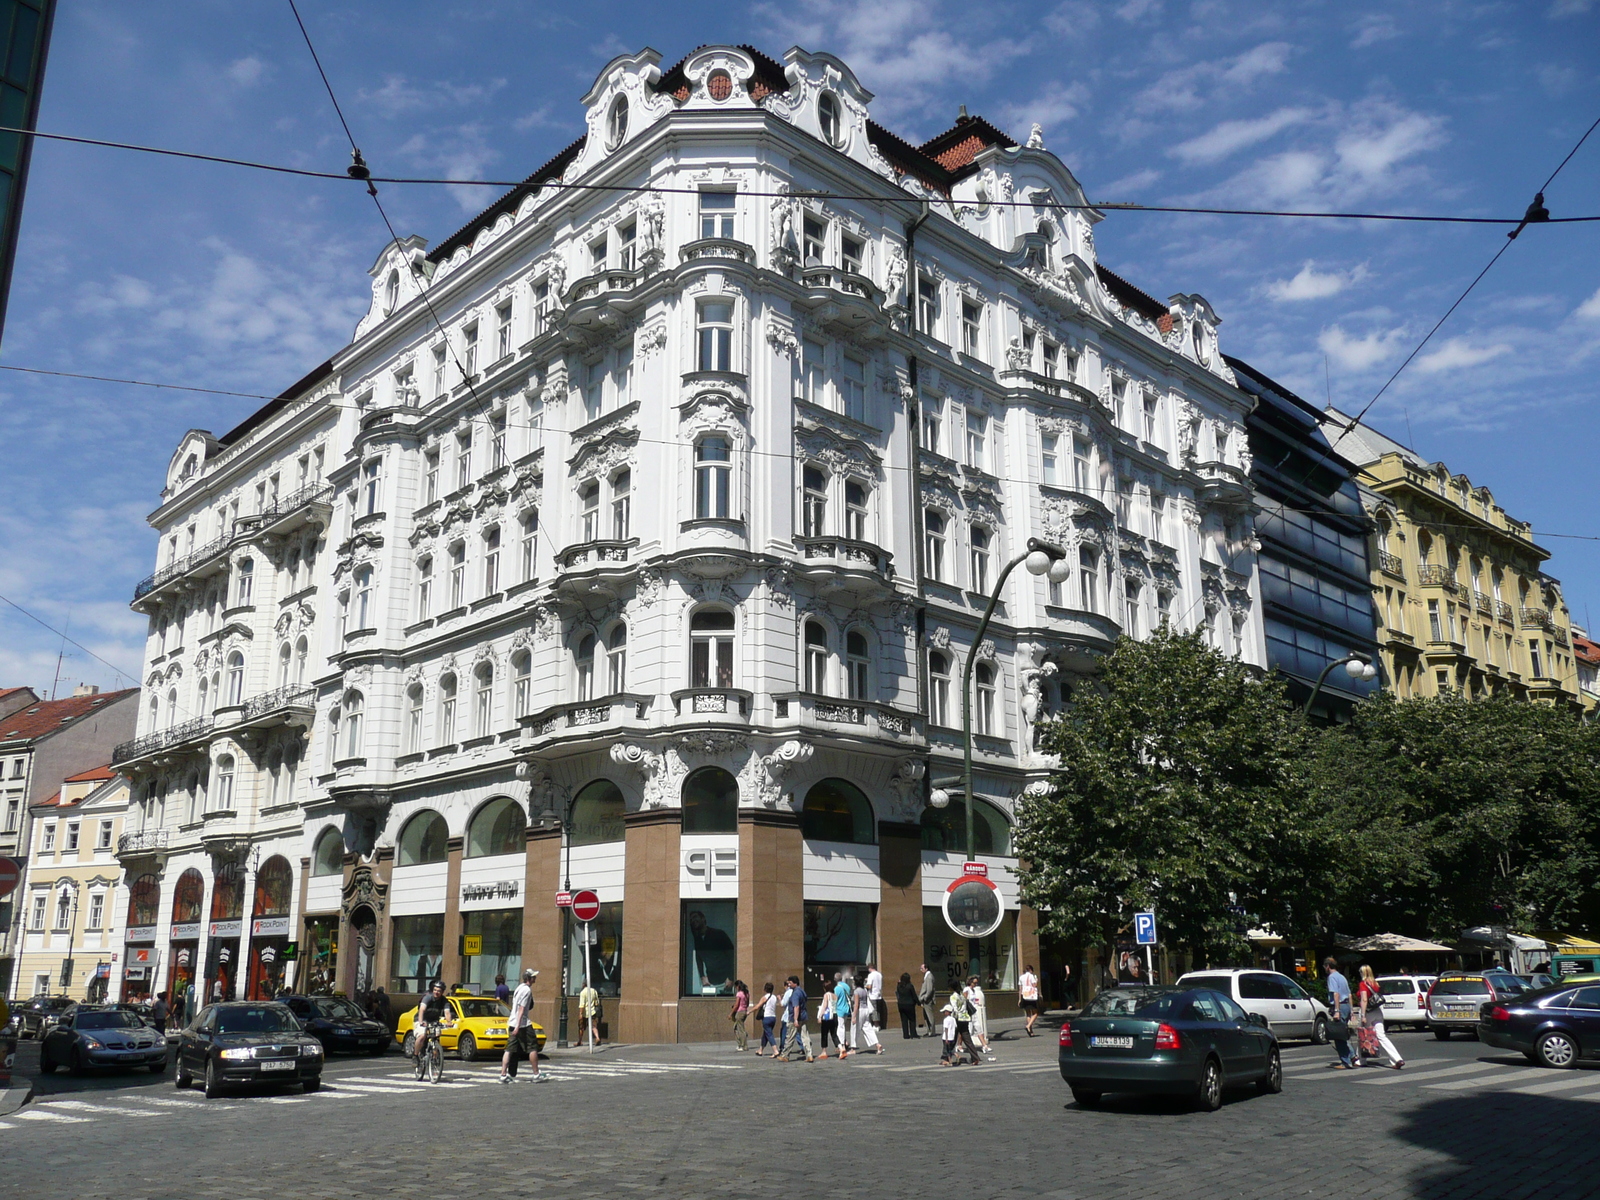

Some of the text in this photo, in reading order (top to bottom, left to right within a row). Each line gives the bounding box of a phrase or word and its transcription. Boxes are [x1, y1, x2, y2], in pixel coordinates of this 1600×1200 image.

[1139, 916, 1151, 935] P
[467, 941, 478, 949] TAXI
[930, 944, 1008, 957] SALE SALE
